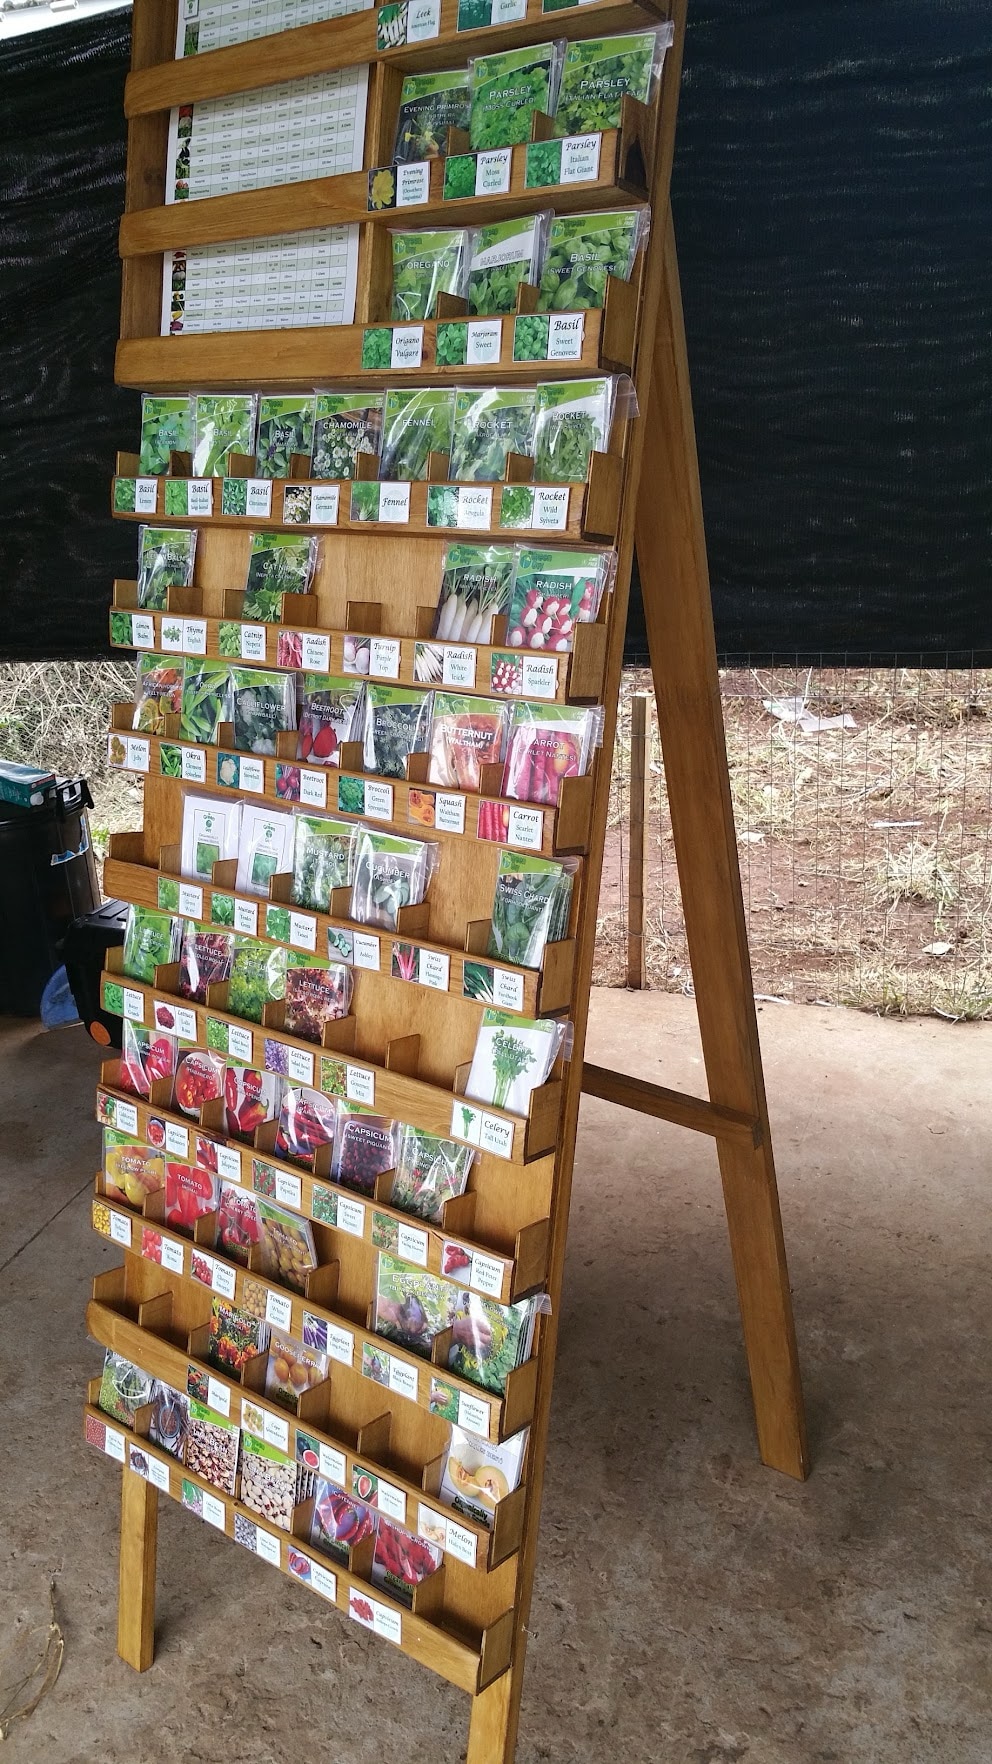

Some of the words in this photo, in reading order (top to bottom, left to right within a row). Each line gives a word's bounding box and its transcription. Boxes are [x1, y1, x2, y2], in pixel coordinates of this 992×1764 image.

[416, 8, 431, 19] Leek
[580, 78, 630, 89] PARSLEY
[489, 85, 532, 100] PARSLEY
[404, 105, 434, 114] EVENING
[566, 138, 596, 150] Parsley
[480, 153, 508, 165] Parsley
[570, 154, 589, 162] Italian
[403, 167, 423, 176] Evening
[577, 166, 594, 174] Giant
[402, 177, 424, 185] Primrose
[482, 179, 502, 187] Curled
[570, 253, 600, 262] BASIL
[407, 260, 449, 269] OREGANO
[554, 318, 581, 331] Basil
[553, 411, 587, 420] ROCKET
[323, 422, 372, 430] CHAMOMILE
[403, 419, 434, 427] FENNEL
[474, 421, 512, 429] ROCKET
[159, 429, 176, 437] BASIL
[275, 430, 295, 438] BASIL
[139, 484, 155, 494] Basil
[192, 484, 209, 494] Basil
[250, 487, 270, 496] Basil
[462, 496, 488, 504] Rocket
[538, 492, 566, 501] Rocket
[382, 497, 408, 507] Fennel
[463, 574, 497, 583] RADISH
[536, 581, 572, 590] RADISH
[186, 626, 204, 635] Thyme
[244, 630, 263, 641] Catnip
[306, 638, 326, 646] Radish
[374, 642, 396, 653] Turnip
[376, 655, 391, 663] Purple
[446, 650, 473, 661] Radish
[526, 664, 554, 675] Radish
[451, 673, 465, 682] Icicle
[528, 677, 550, 687] Sparkler
[311, 703, 343, 714] BEETROOT
[376, 718, 416, 731] BROCCOLI
[442, 725, 493, 741] BUTTERNUT
[185, 752, 201, 761] Okra
[302, 774, 324, 784] Beetroot
[368, 784, 391, 795] Broccoli
[438, 797, 462, 808] Squash
[439, 809, 460, 817] Waltham
[513, 811, 539, 822] Carrot
[516, 826, 533, 834] Scarlet
[515, 834, 534, 843] Nantes
[306, 847, 344, 861] MUSTARD
[366, 862, 410, 879] CUCUMBER
[499, 884, 522, 896] SWISS
[524, 891, 550, 903] CHARD
[294, 922, 314, 931] Mustard
[355, 939, 377, 948] Cucumber
[195, 944, 222, 957] LETTUCE
[359, 951, 373, 959] Ashley
[427, 953, 441, 963] Swiss
[426, 962, 443, 972] Chard
[501, 973, 516, 983] Swiss
[299, 980, 329, 995] LETTUCE
[500, 982, 518, 992] Chard
[231, 1028, 250, 1040] Lettuce
[130, 1039, 165, 1055] APSICUM
[291, 1050, 311, 1063] Lettuce
[185, 1057, 219, 1074] CAPSICUM
[349, 1069, 371, 1081] Lettuce
[348, 1124, 392, 1142] CAPSICUM
[484, 1120, 509, 1138] Celery
[121, 1156, 151, 1167] TOMATO
[177, 1174, 202, 1190] TOMATO
[401, 1231, 425, 1247] Capsicum
[164, 1242, 182, 1257] Tomato
[215, 1263, 234, 1278] Tomato
[474, 1258, 501, 1273] Capsicum
[477, 1277, 494, 1288] Pepper
[269, 1294, 290, 1308] Tomato
[449, 1527, 474, 1547] Melon
